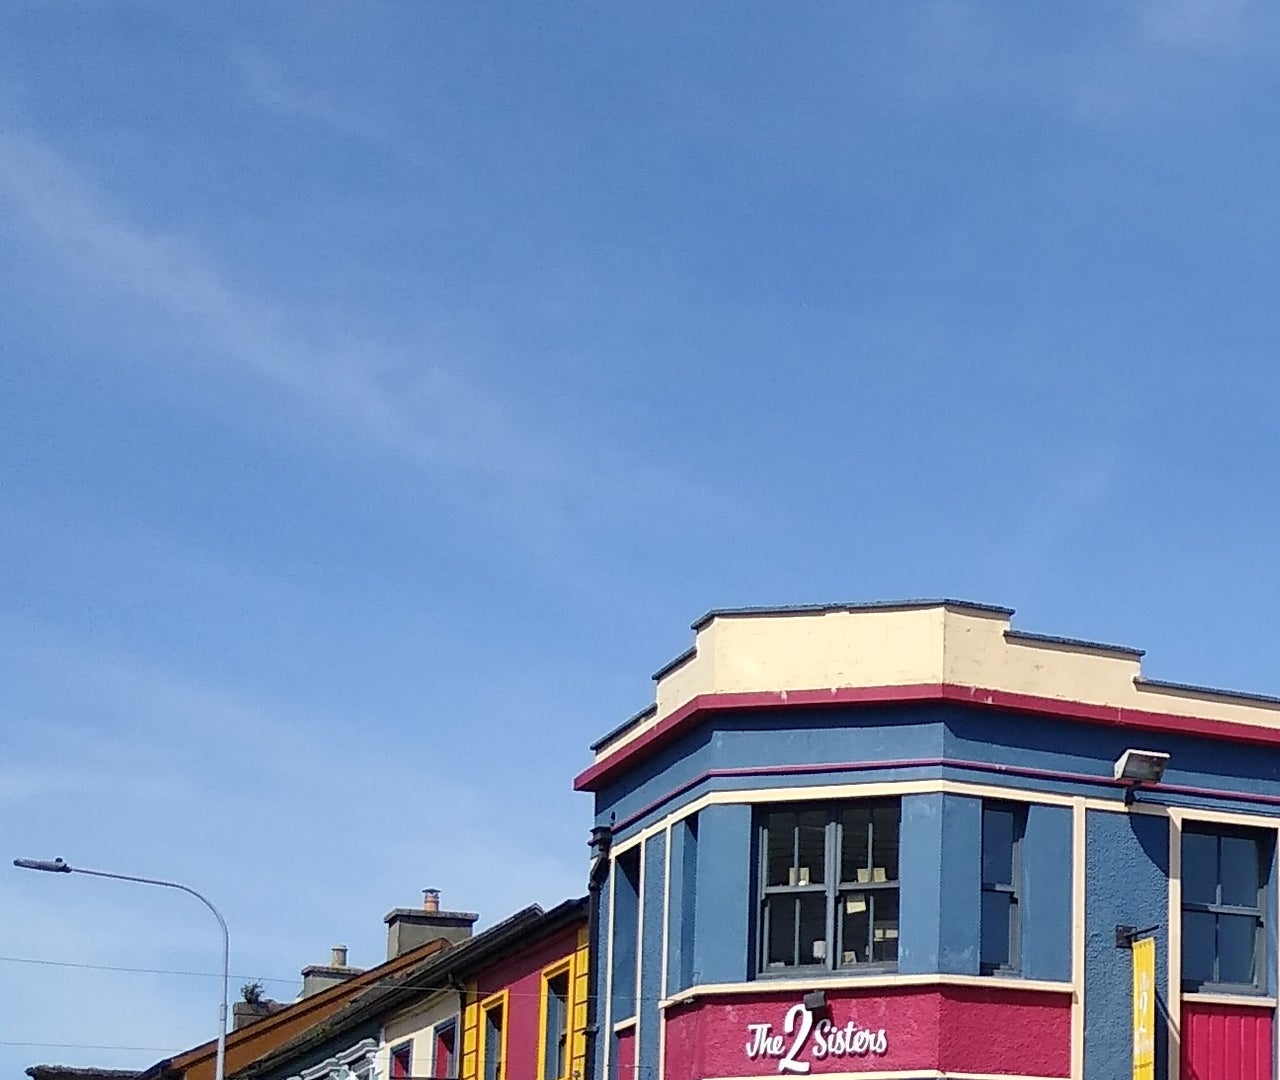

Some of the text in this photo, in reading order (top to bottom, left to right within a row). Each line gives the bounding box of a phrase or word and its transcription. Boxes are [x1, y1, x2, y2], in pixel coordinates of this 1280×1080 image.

[746, 1003, 887, 1072] The 2 Sisters
